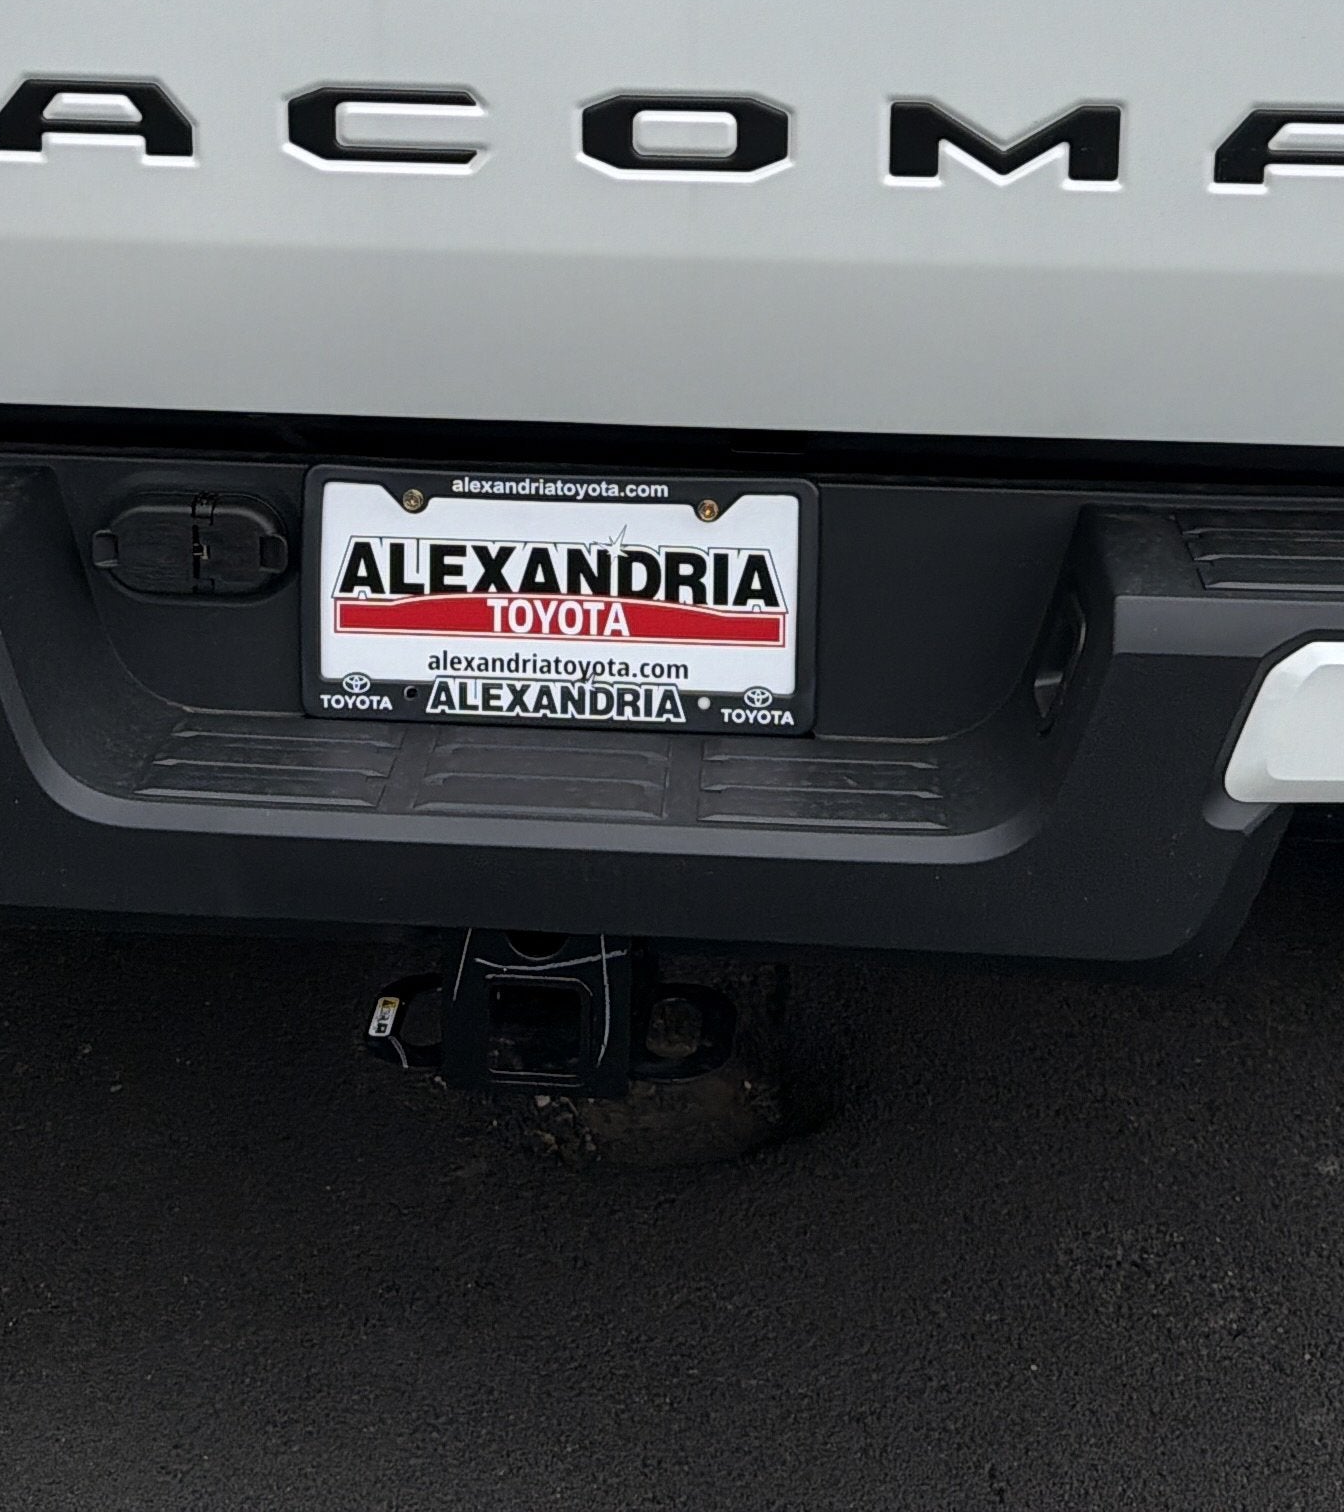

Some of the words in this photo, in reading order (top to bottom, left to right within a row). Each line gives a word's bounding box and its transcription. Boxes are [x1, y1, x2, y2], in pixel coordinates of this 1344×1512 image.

[451, 476, 669, 502] alexandriatoyota.com
[336, 536, 784, 610] ALEXANDRIA
[486, 597, 630, 638] TOYOTA
[426, 651, 690, 684] alexandriatoyota.com
[320, 694, 393, 712] TOYOTA
[426, 675, 686, 724] ALEXANDRIA
[720, 708, 795, 727] TOYOTA
